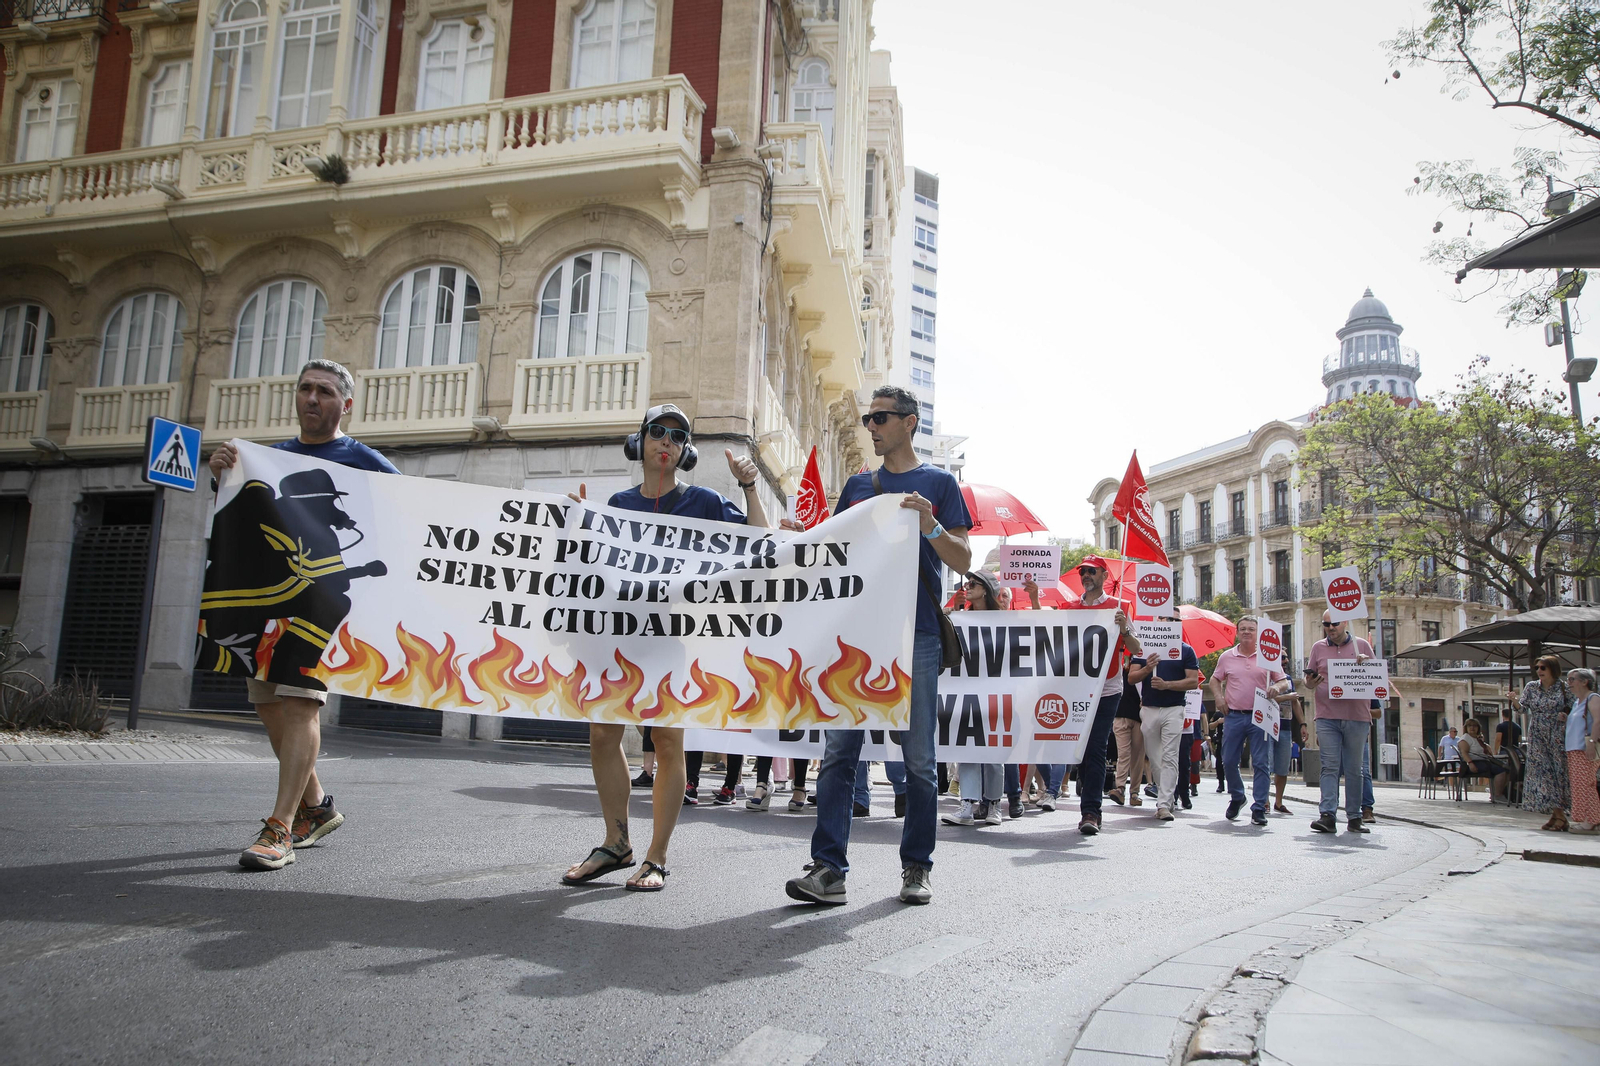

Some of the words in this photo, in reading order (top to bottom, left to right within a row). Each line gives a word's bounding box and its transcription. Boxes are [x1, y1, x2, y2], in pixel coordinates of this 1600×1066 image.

[500, 499, 570, 529] SIN
[579, 508, 786, 557] INVERSIÓ
[423, 524, 480, 552] NO
[491, 532, 543, 561] SE
[554, 539, 686, 575] PUEDE
[792, 541, 850, 567] UN
[1010, 549, 1052, 557] JORNADA
[1022, 561, 1052, 569] HORAS
[416, 557, 605, 600] SERVICIO
[616, 579, 670, 603] DE
[683, 574, 864, 604] CALIDAD
[1003, 572, 1023, 581] UGT
[1143, 575, 1163, 583] UEA
[1332, 579, 1352, 588] UEA
[1141, 595, 1167, 604] UEMA
[1329, 589, 1360, 599] ALMERIA
[1334, 598, 1359, 609] UEMA
[479, 600, 531, 630] AL
[543, 607, 783, 637] CIUDADANO
[1263, 630, 1277, 640] UEA
[938, 625, 1109, 678] NVENIO
[1261, 648, 1279, 659] UEMA
[1038, 700, 1064, 713] UGT
[938, 694, 1012, 747] YA!!
